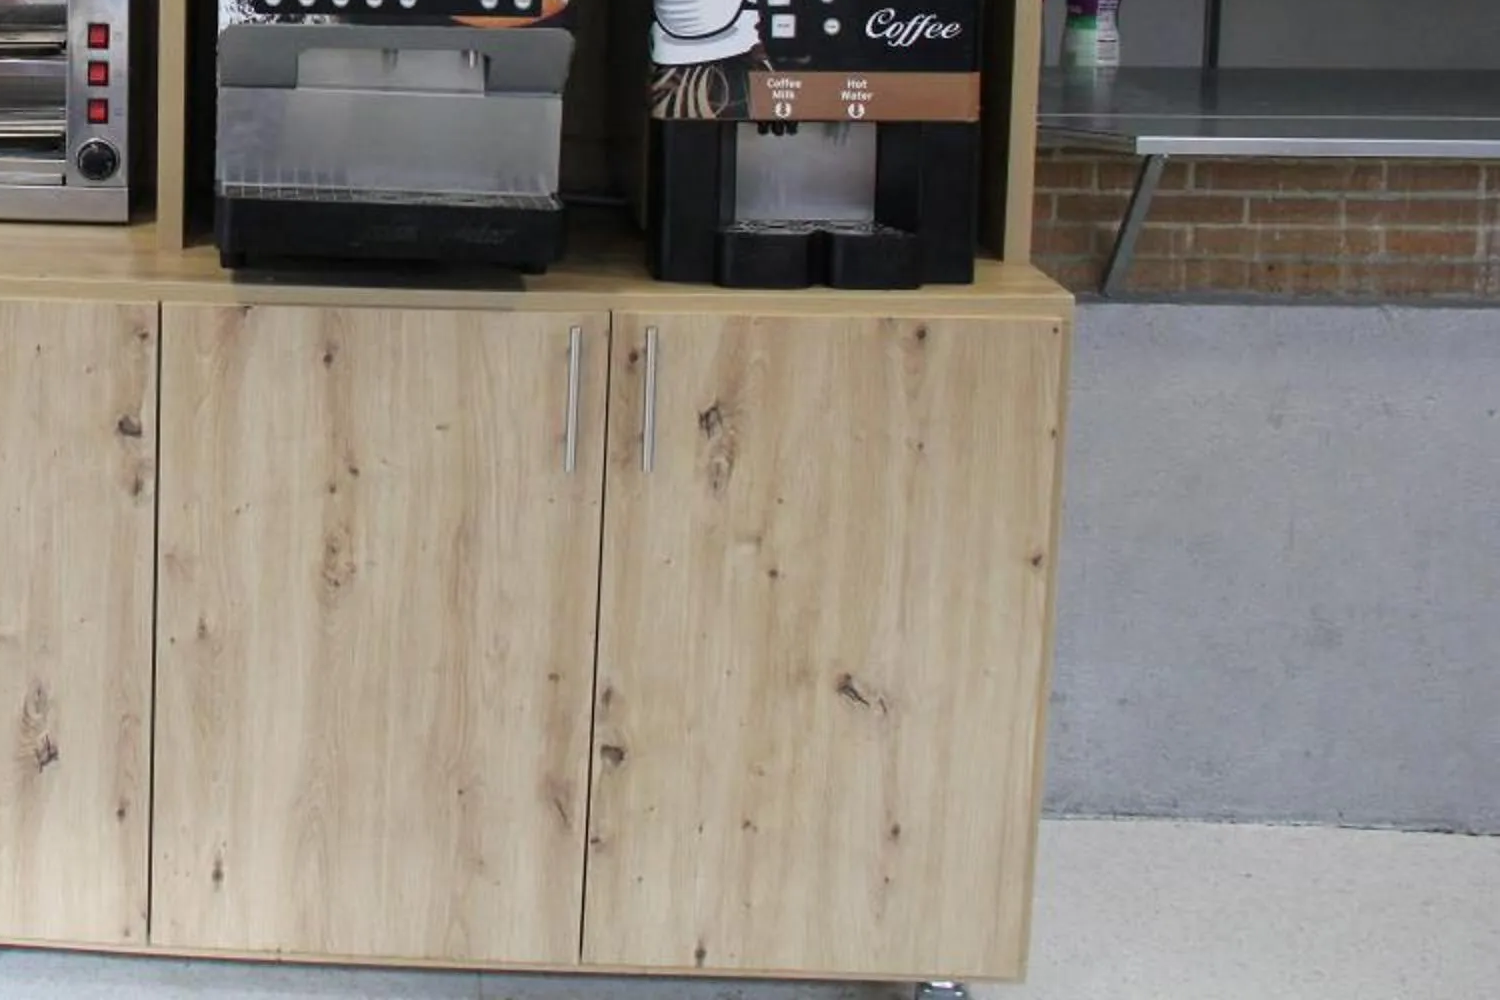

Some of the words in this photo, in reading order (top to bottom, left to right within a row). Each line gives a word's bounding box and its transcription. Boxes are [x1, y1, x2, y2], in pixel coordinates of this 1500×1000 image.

[865, 8, 962, 47] Coffee
[766, 78, 802, 90] Coffee
[846, 78, 868, 90] Hot
[772, 90, 796, 100] Milk
[840, 90, 873, 102] Water
